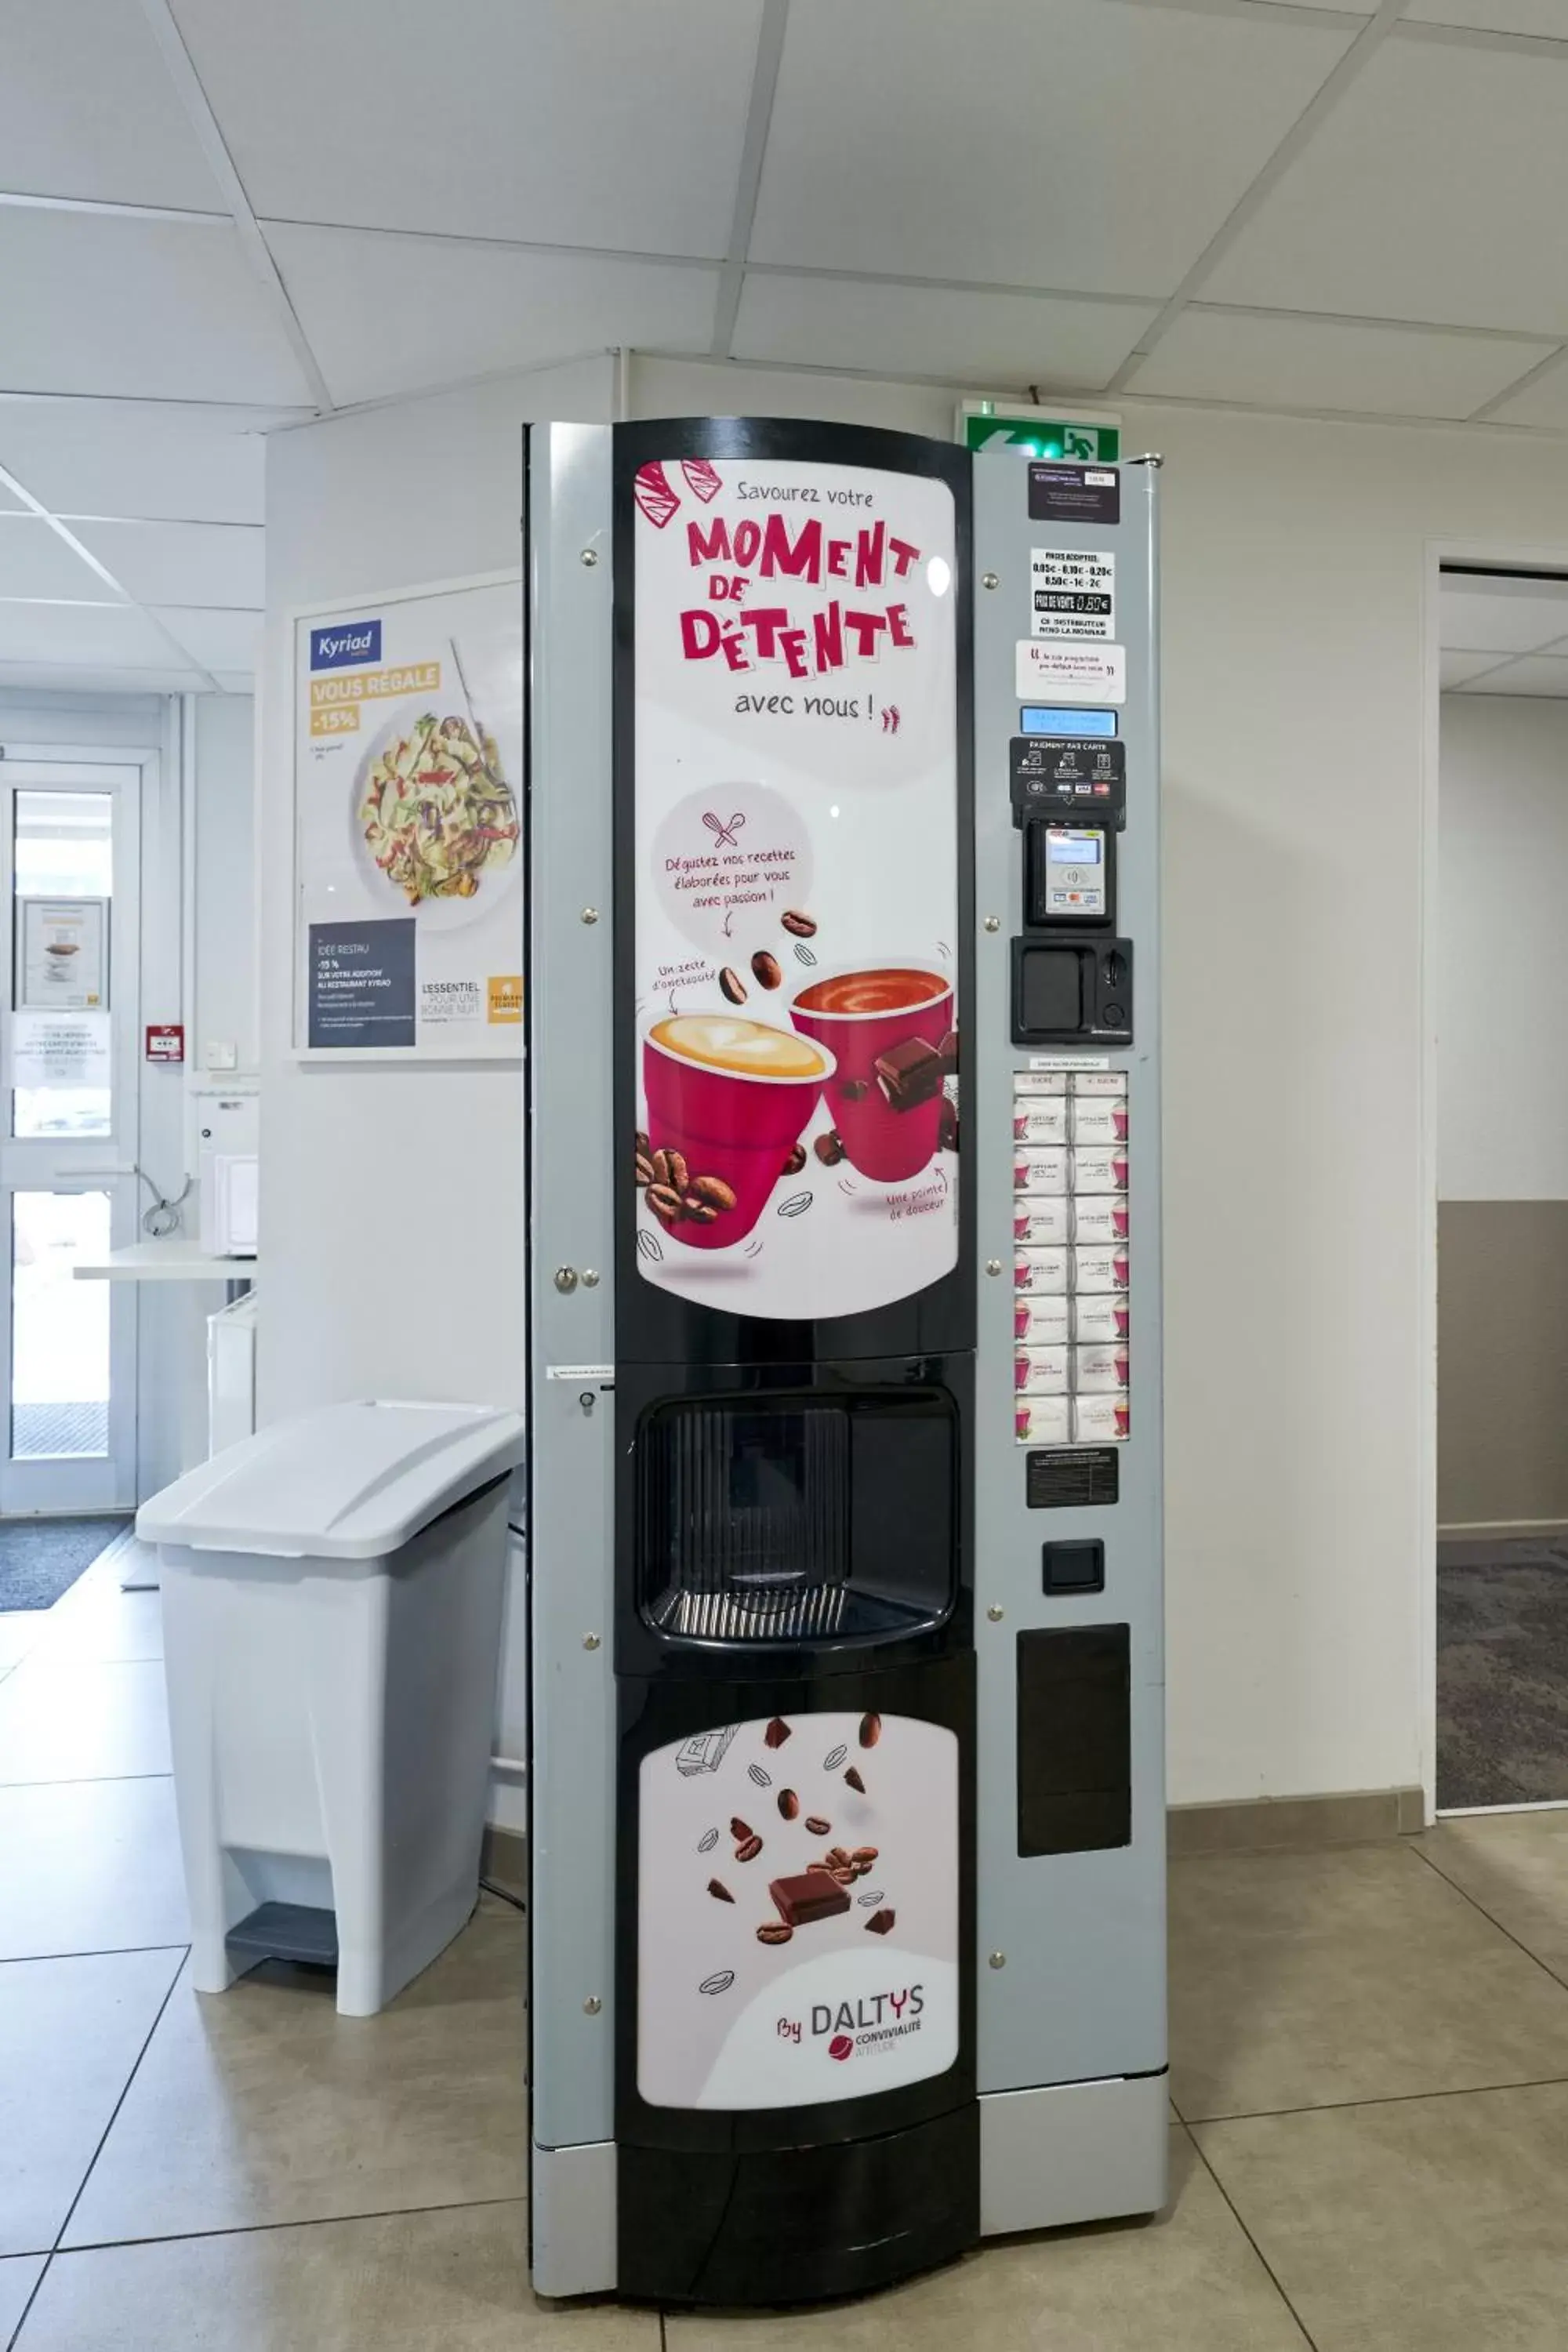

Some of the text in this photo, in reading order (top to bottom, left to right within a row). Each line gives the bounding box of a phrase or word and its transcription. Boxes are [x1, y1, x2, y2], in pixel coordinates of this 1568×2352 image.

[737, 482, 873, 506] Savourez votre
[686, 514, 921, 587] MOMENT
[709, 575, 750, 602] DE
[318, 630, 373, 659] Kyriad
[680, 601, 914, 678] DÉTENTE
[313, 667, 437, 702] VOUS RÉGALE
[735, 695, 793, 715] avec
[804, 695, 859, 719] nous
[314, 710, 358, 731] -15%
[666, 849, 796, 874] Dégustez nos recettes
[674, 871, 790, 890] élaborées pour vous
[693, 895, 720, 908] avec
[724, 891, 767, 908] passion
[658, 966, 673, 976] Un
[890, 1208, 901, 1221] de
[777, 1984, 924, 2044] By DALTYS
[855, 2018, 921, 2045] CONVIVIALITÉ
